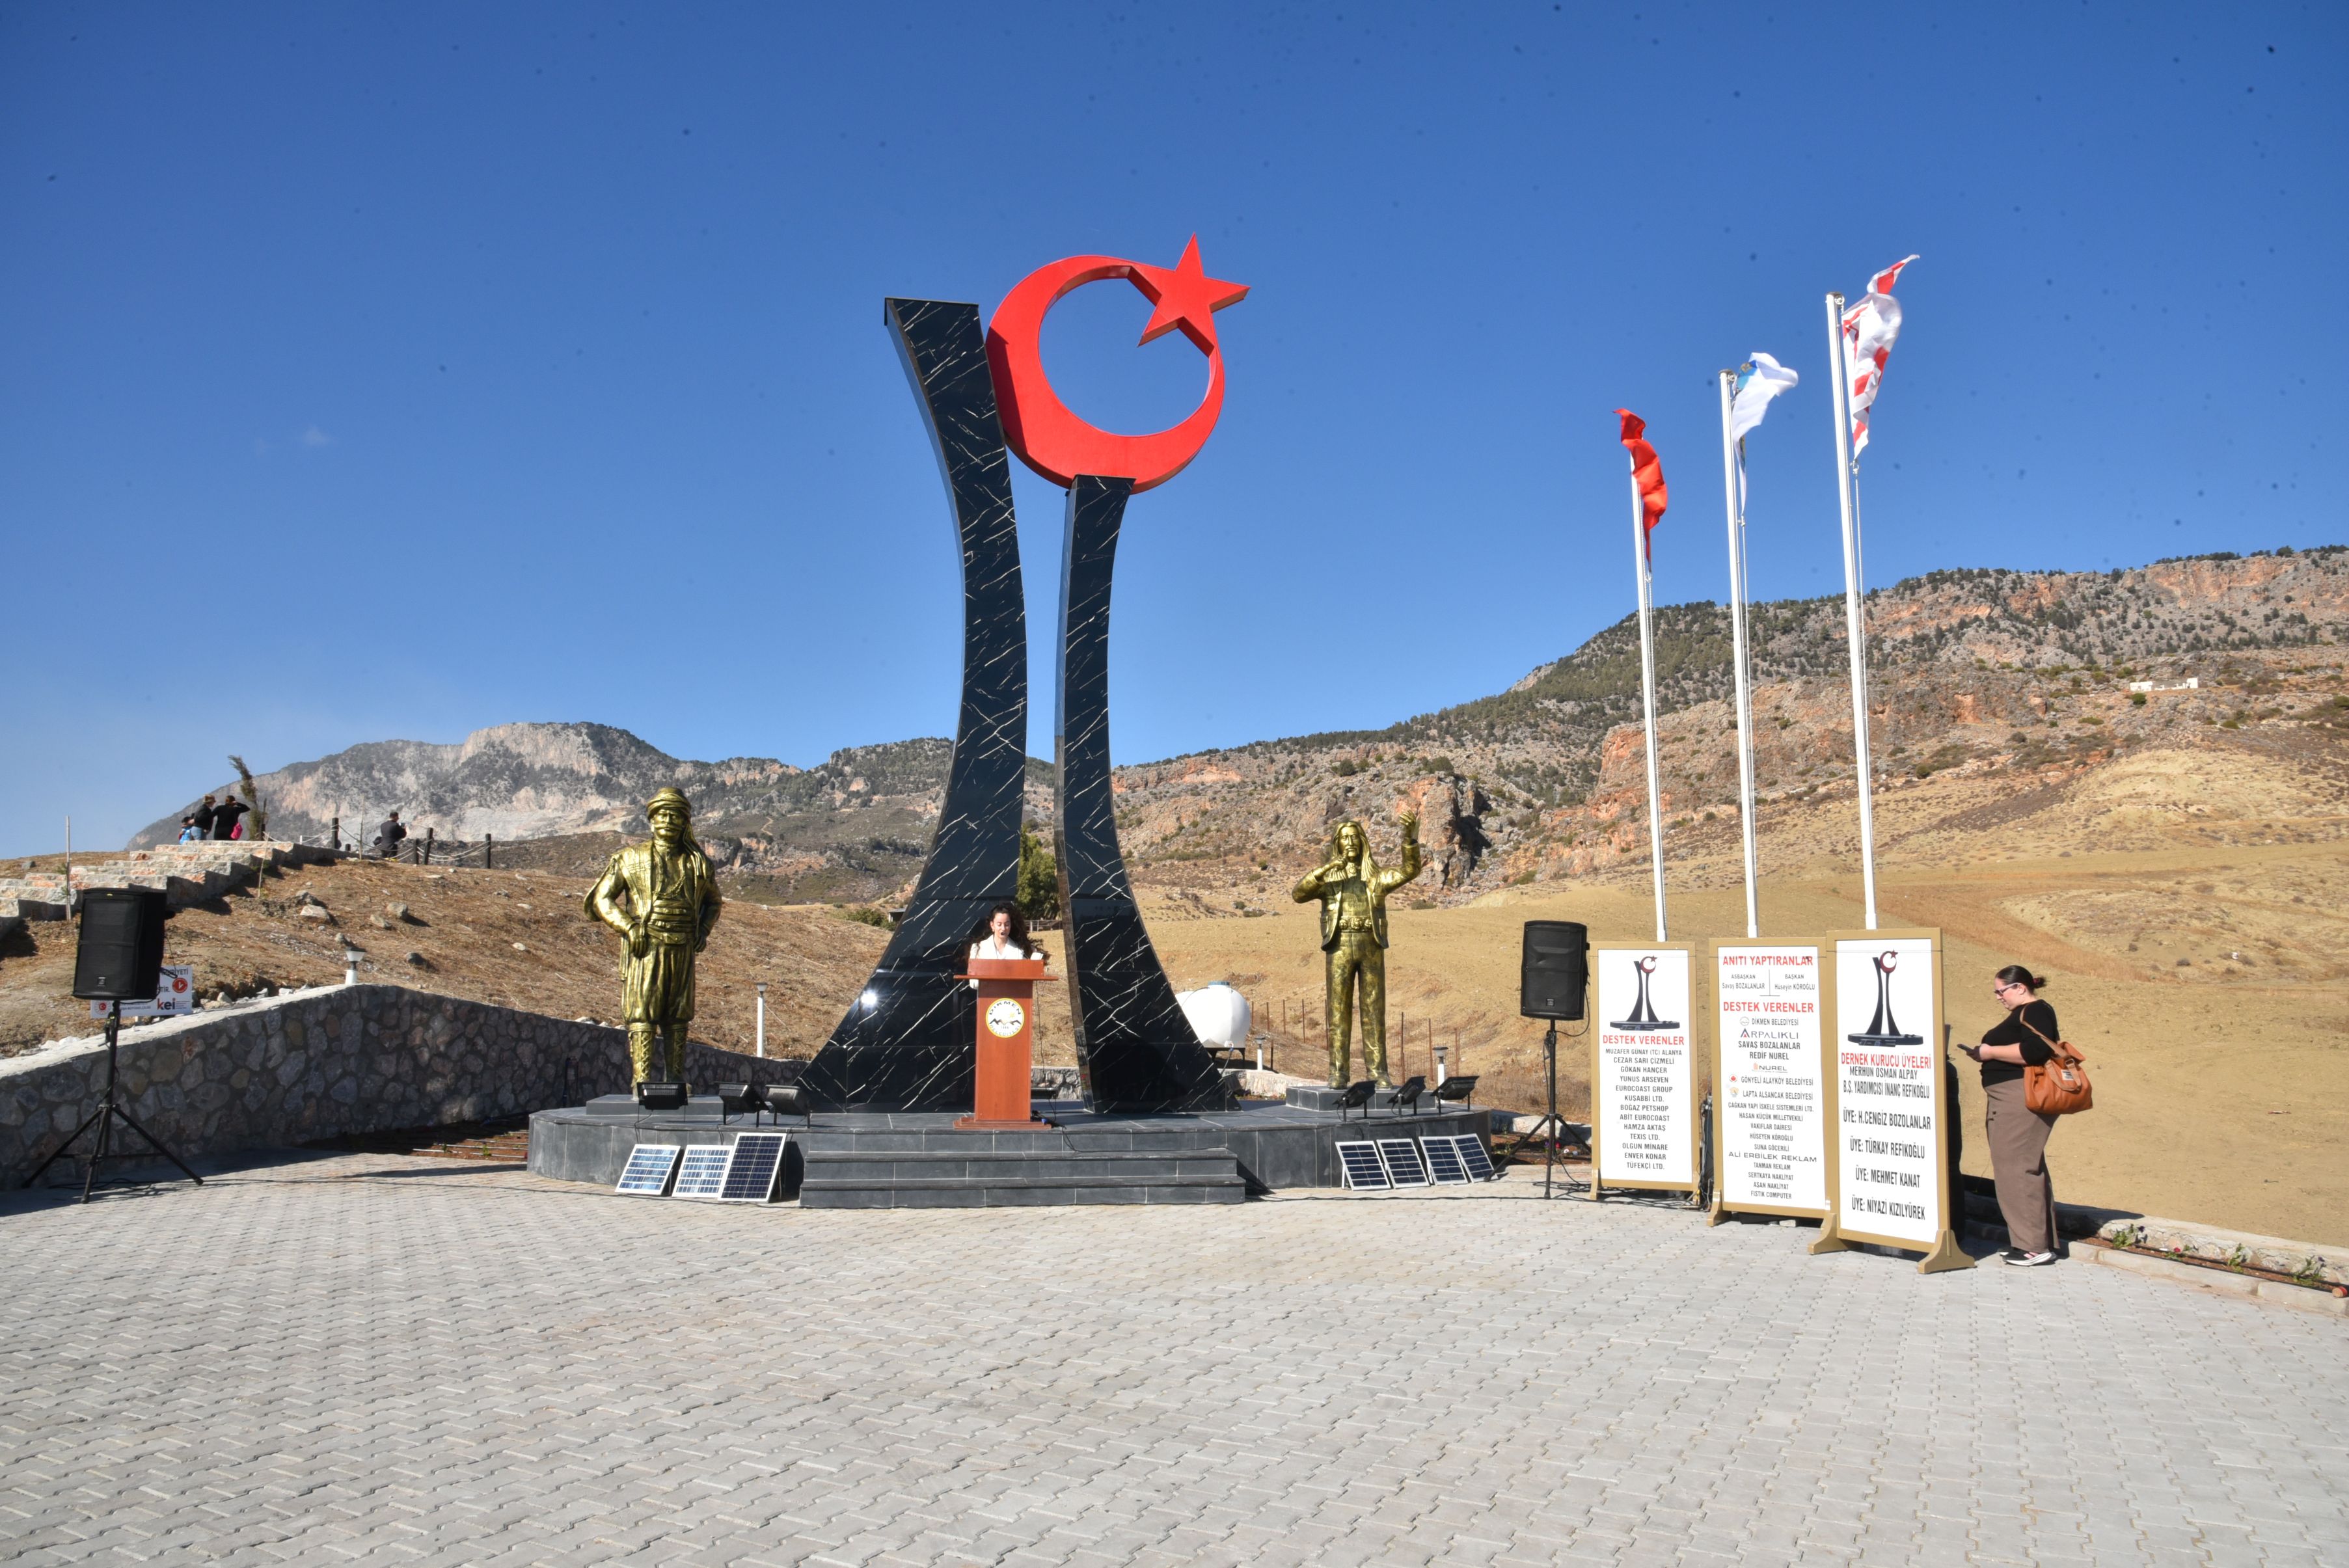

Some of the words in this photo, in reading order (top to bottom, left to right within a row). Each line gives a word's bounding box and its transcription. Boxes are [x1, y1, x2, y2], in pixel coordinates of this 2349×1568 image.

[1723, 956, 1746, 966] ANITI
[1750, 956, 1813, 966] YAPTIRANLAR
[157, 998, 176, 1010] kei
[1724, 1002, 1759, 1012] DESTEK
[1763, 1003, 1813, 1012] VERENLER
[1741, 1028, 1799, 1039] ARPALIKLI
[1603, 1035, 1636, 1044] DESTEK
[1639, 1036, 1684, 1045] VERENLER
[1750, 1051, 1767, 1059] REDİF
[1841, 1053, 1868, 1065] DERNEK
[1871, 1054, 1899, 1067] KURUCU
[1902, 1053, 1931, 1068] ÜYELERİ
[1850, 1066, 1873, 1077] MERHUN
[1876, 1068, 1897, 1078] OSMAN
[1899, 1069, 1918, 1079] ALPAY
[1763, 1076, 1784, 1085] ALAYKÖY
[1786, 1077, 1813, 1086] BELEDİYESİ
[1854, 1081, 1883, 1095] YARDIMCISI
[1884, 1080, 1900, 1098] İNANÇ
[1903, 1082, 1929, 1098] REFİKOĞLU
[1843, 1107, 1856, 1123] ÜYE:
[1858, 1109, 1887, 1126] H.CENGİZ
[1890, 1113, 1931, 1129] BOZOLANLAR
[1851, 1136, 1863, 1152] ÜYE:
[1866, 1137, 1888, 1155] TÜRKAY
[1891, 1141, 1925, 1159] REFİKOĞLU
[1856, 1165, 1868, 1182] ÜYE:
[1871, 1169, 1897, 1185] MEHMET
[1900, 1172, 1920, 1187] KANAT
[1852, 1194, 1865, 1211] ÜYE:
[1867, 1197, 1887, 1214] NİYAZİ
[1890, 1202, 1925, 1220] KIZILYÜREK
